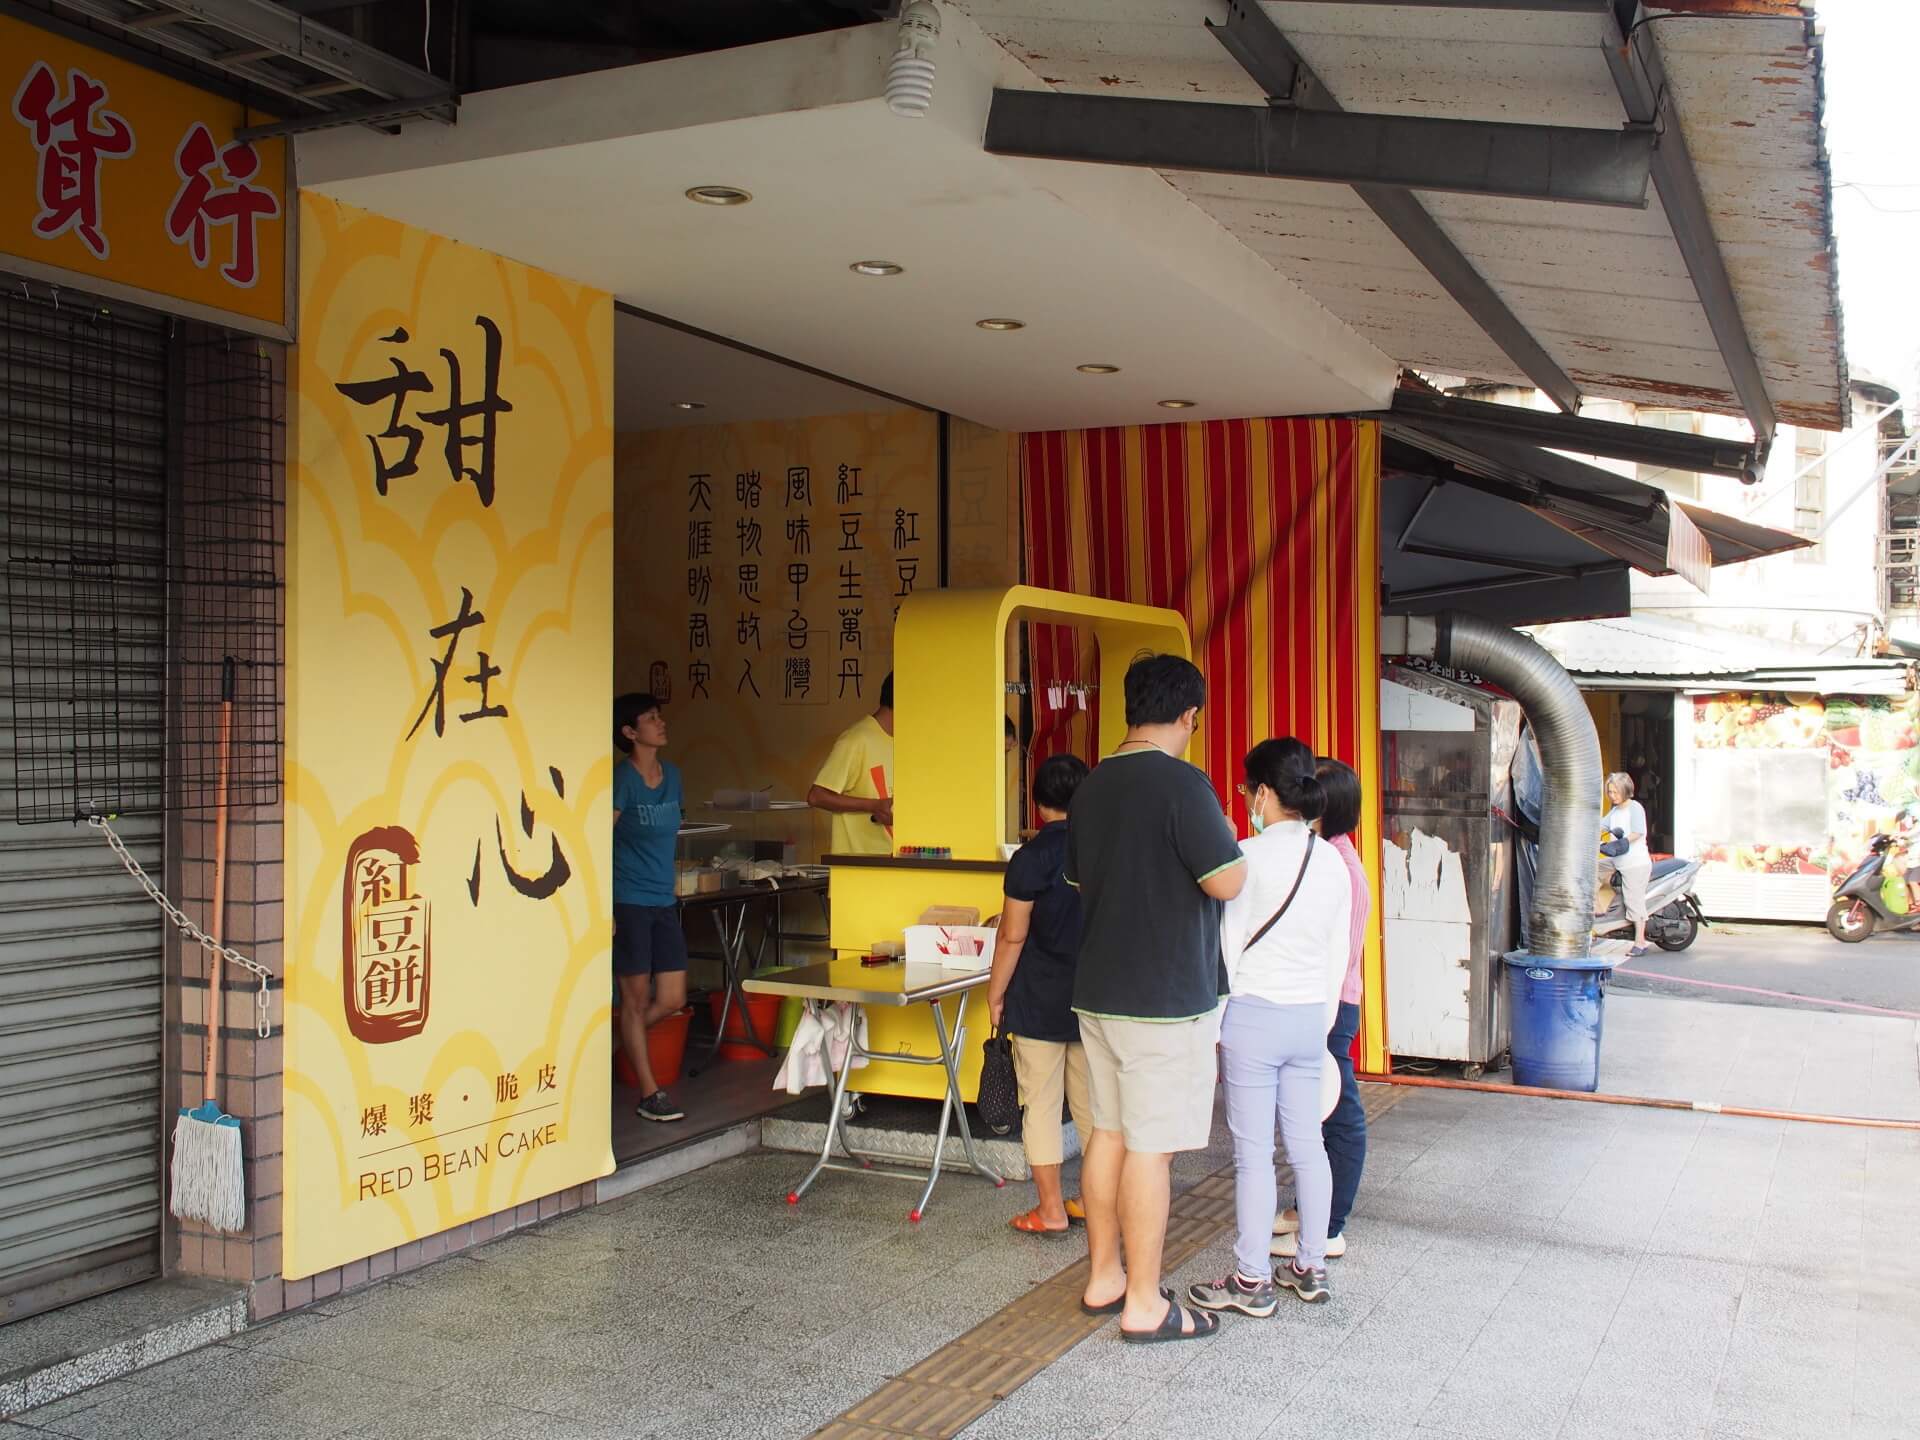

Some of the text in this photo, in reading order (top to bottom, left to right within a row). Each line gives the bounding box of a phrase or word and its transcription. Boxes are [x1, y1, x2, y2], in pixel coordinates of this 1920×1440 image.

[17, 63, 279, 286] 貨行
[335, 316, 571, 907] 甜在心
[736, 470, 762, 698] 睹物思故人
[785, 467, 811, 698] 風味甲台灣
[837, 464, 863, 698] 紅豆生萬丹
[894, 508, 921, 621] 紅豆
[361, 857, 424, 1011] 紅豆餅
